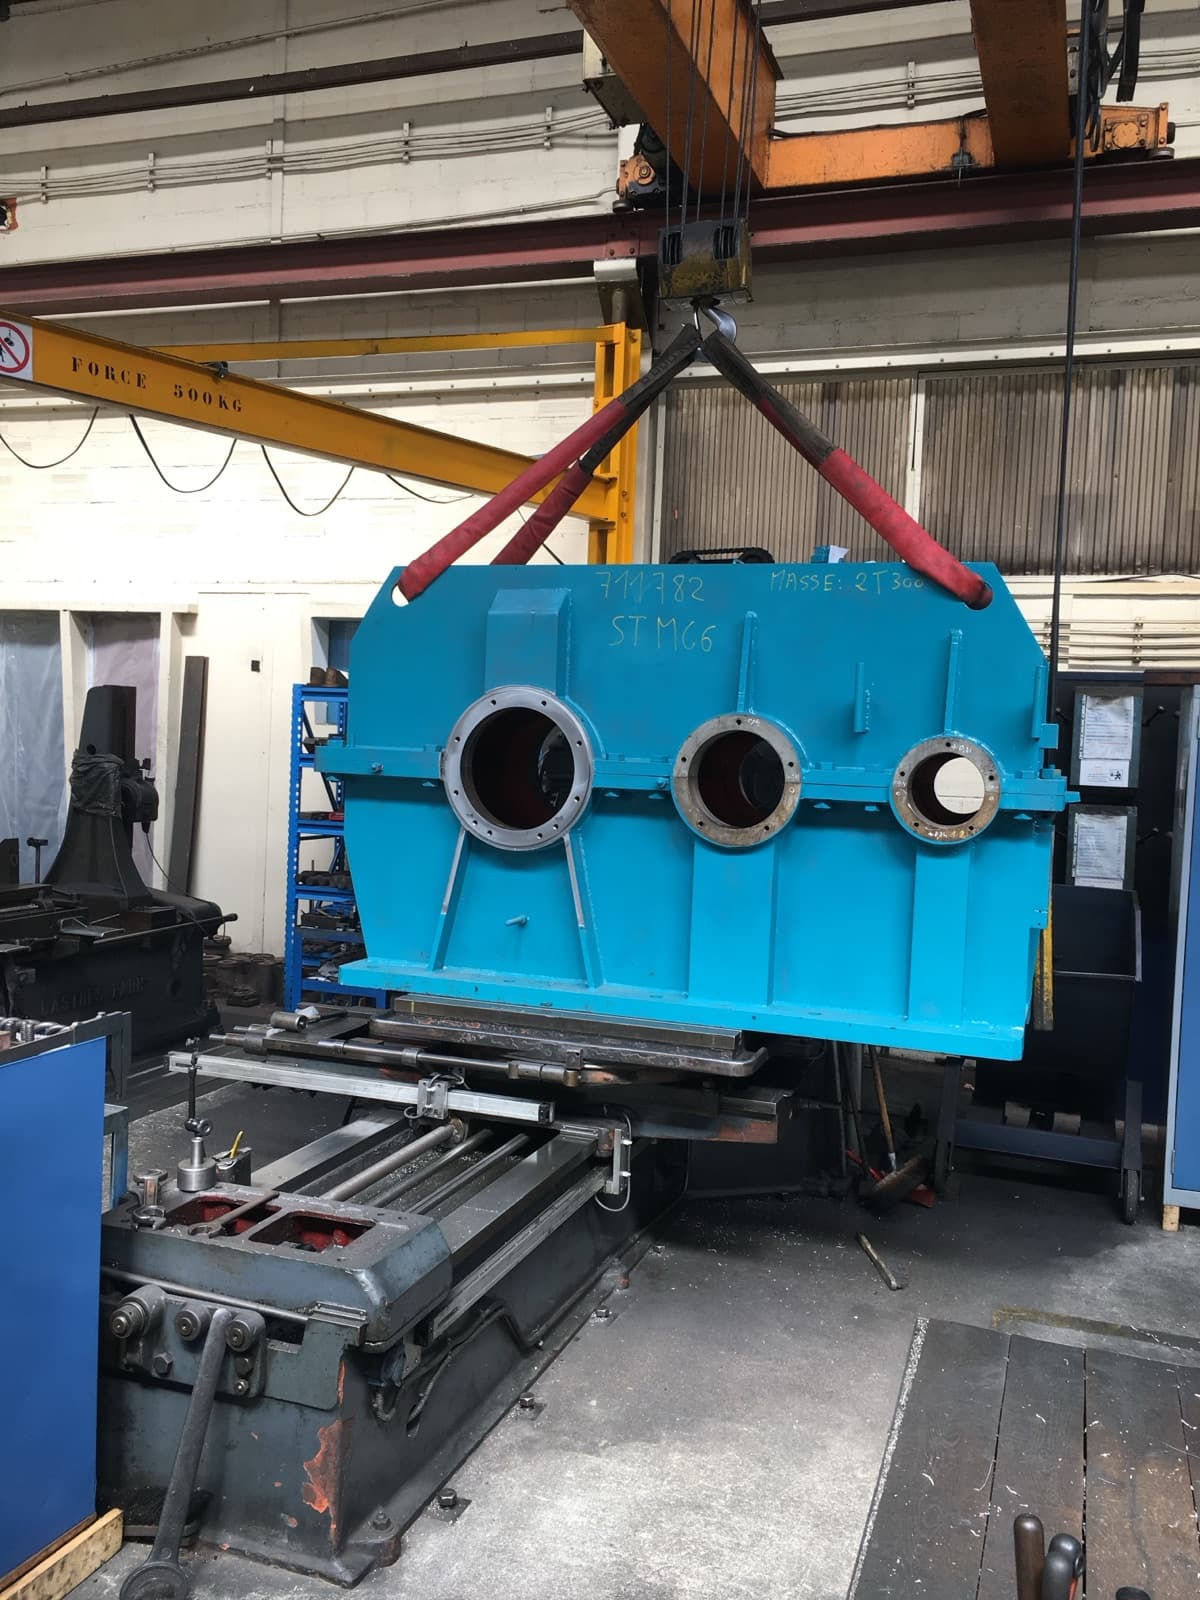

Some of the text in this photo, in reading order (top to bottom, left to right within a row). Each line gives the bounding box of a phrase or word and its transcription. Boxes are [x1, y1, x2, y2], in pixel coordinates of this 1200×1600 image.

[71, 356, 242, 413] FORCE 500KG
[770, 568, 842, 592] MASSE:
